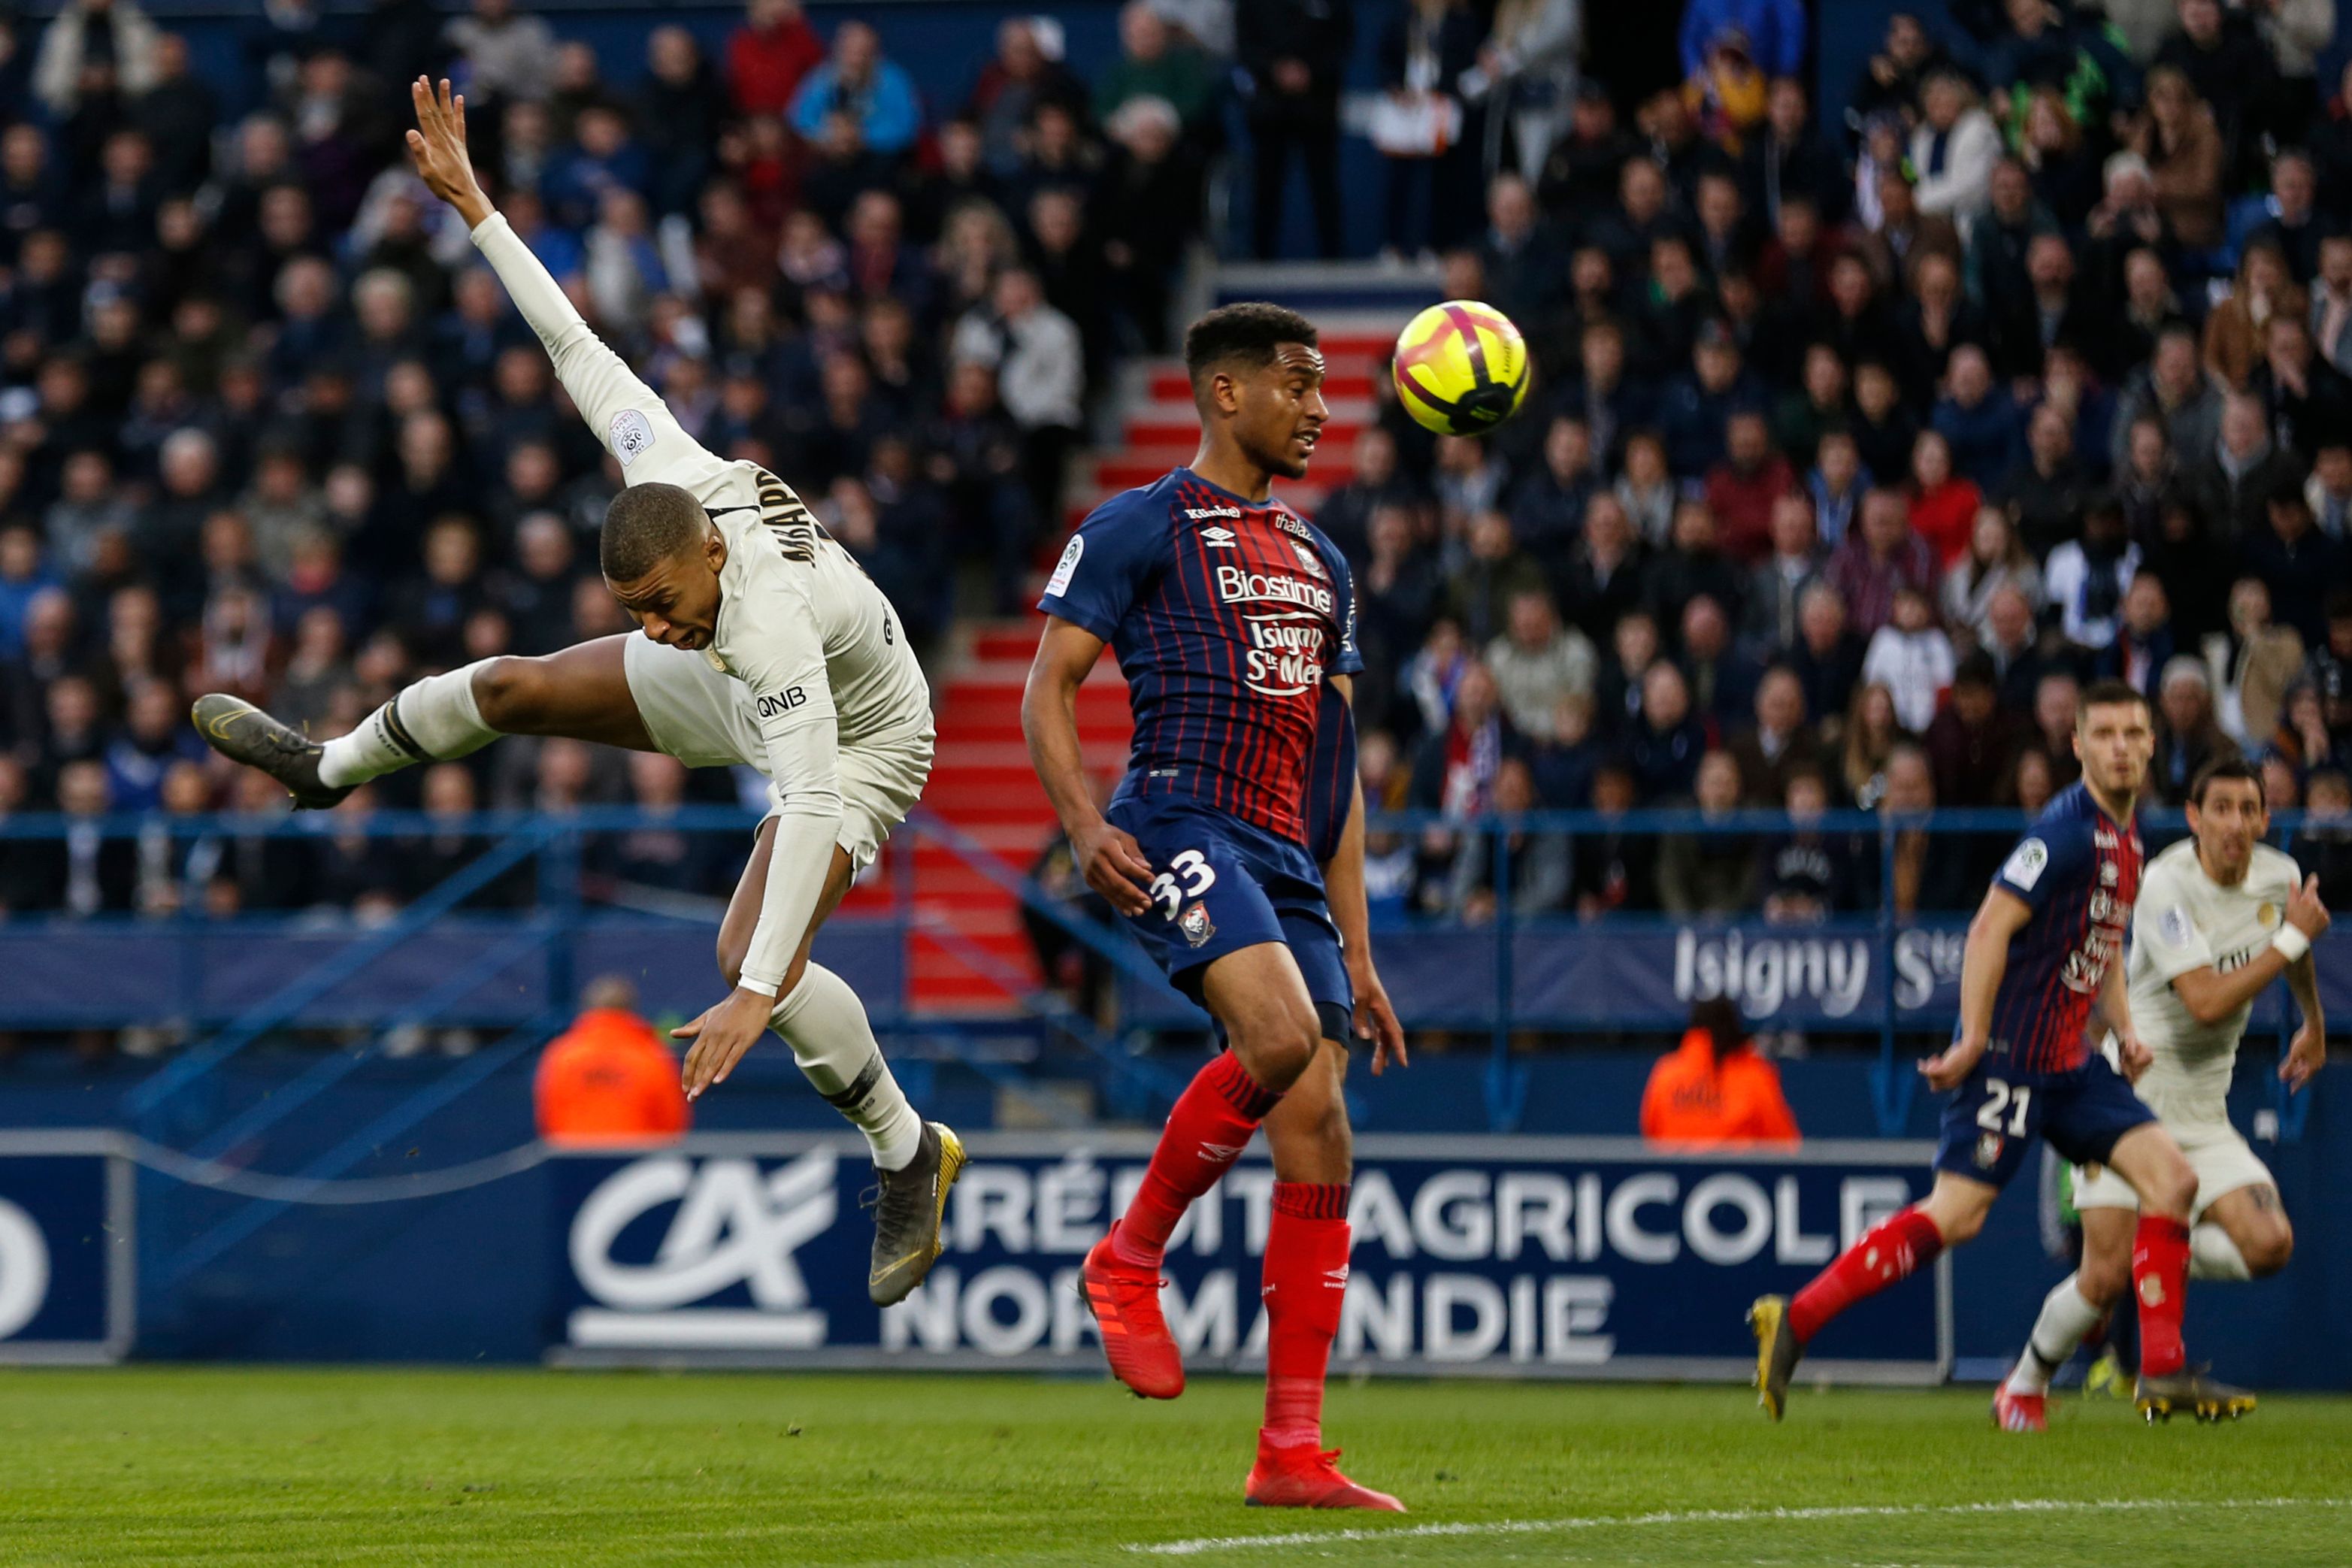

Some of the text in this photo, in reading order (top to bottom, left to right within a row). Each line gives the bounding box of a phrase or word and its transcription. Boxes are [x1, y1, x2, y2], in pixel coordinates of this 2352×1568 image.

[1217, 566, 1331, 613] Biostime
[1251, 622, 1323, 658] Isigny
[1280, 655, 1324, 686] Mèr
[758, 686, 807, 718] QNB
[1150, 849, 1216, 922] 33
[1674, 927, 1870, 1020] Isigny
[1977, 1078, 2030, 1137] 21
[938, 1148, 1911, 1266] RÉIT AGRICOLE
